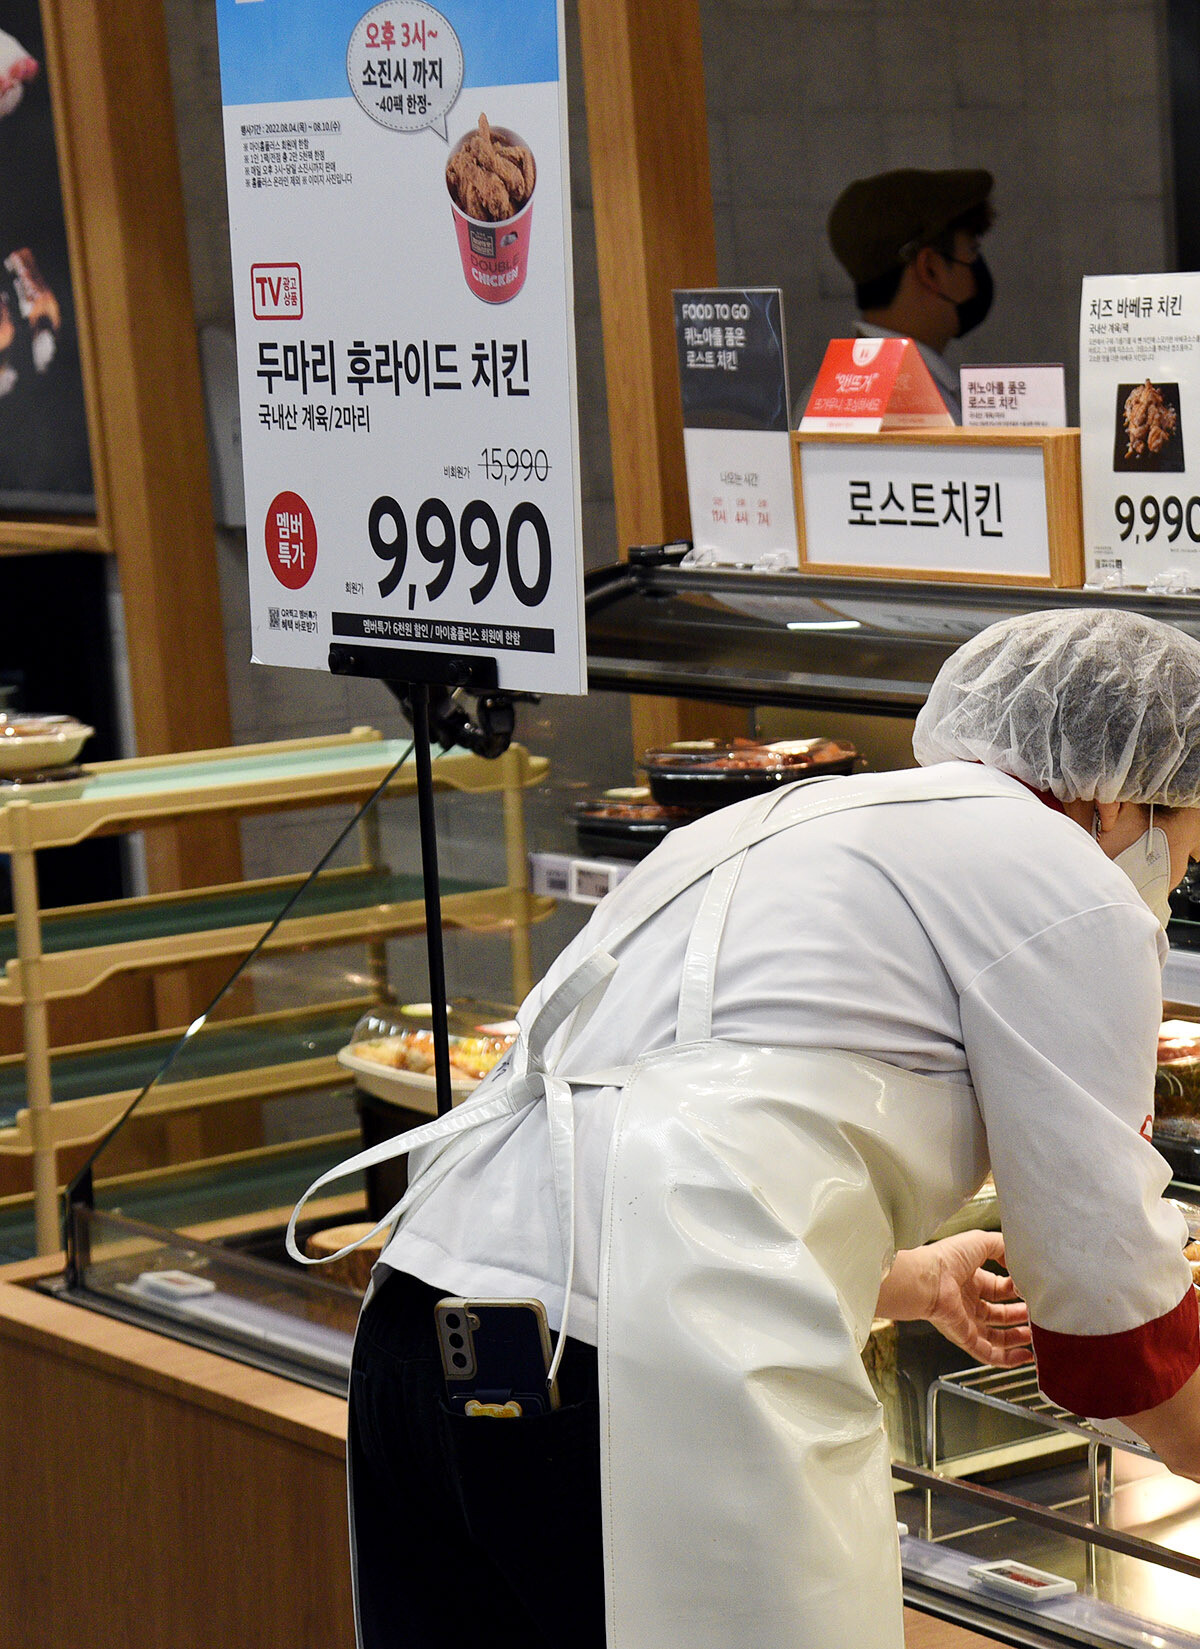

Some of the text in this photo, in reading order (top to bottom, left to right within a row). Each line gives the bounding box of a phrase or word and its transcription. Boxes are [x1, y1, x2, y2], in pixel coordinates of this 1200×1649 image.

[365, 19, 438, 51] 오후 3시~
[362, 57, 443, 89] 소진시 까지
[471, 266, 519, 287] CHICKEN
[255, 276, 282, 307] TV
[682, 304, 750, 320] FOOD TO GO
[1090, 294, 1182, 320] 치즈 바베큐 치킨
[724, 327, 746, 348] 품은
[1090, 323, 1107, 334] 국내산
[256, 339, 530, 397] 두마리 후라이드 치킨
[686, 350, 738, 371] 로스트 치킨
[968, 396, 1018, 410] 로스트 치킨
[258, 404, 371, 433] 국내산 계육/2마리
[477, 448, 552, 486] 15,990
[848, 480, 1003, 537] 로스트치킨
[276, 512, 304, 540] 멤버
[278, 541, 306, 570] 특가
[368, 495, 552, 611] 9,990
[363, 619, 521, 646] 멤버특가 6천원 할인 마이홈플러스 회원에 한함
